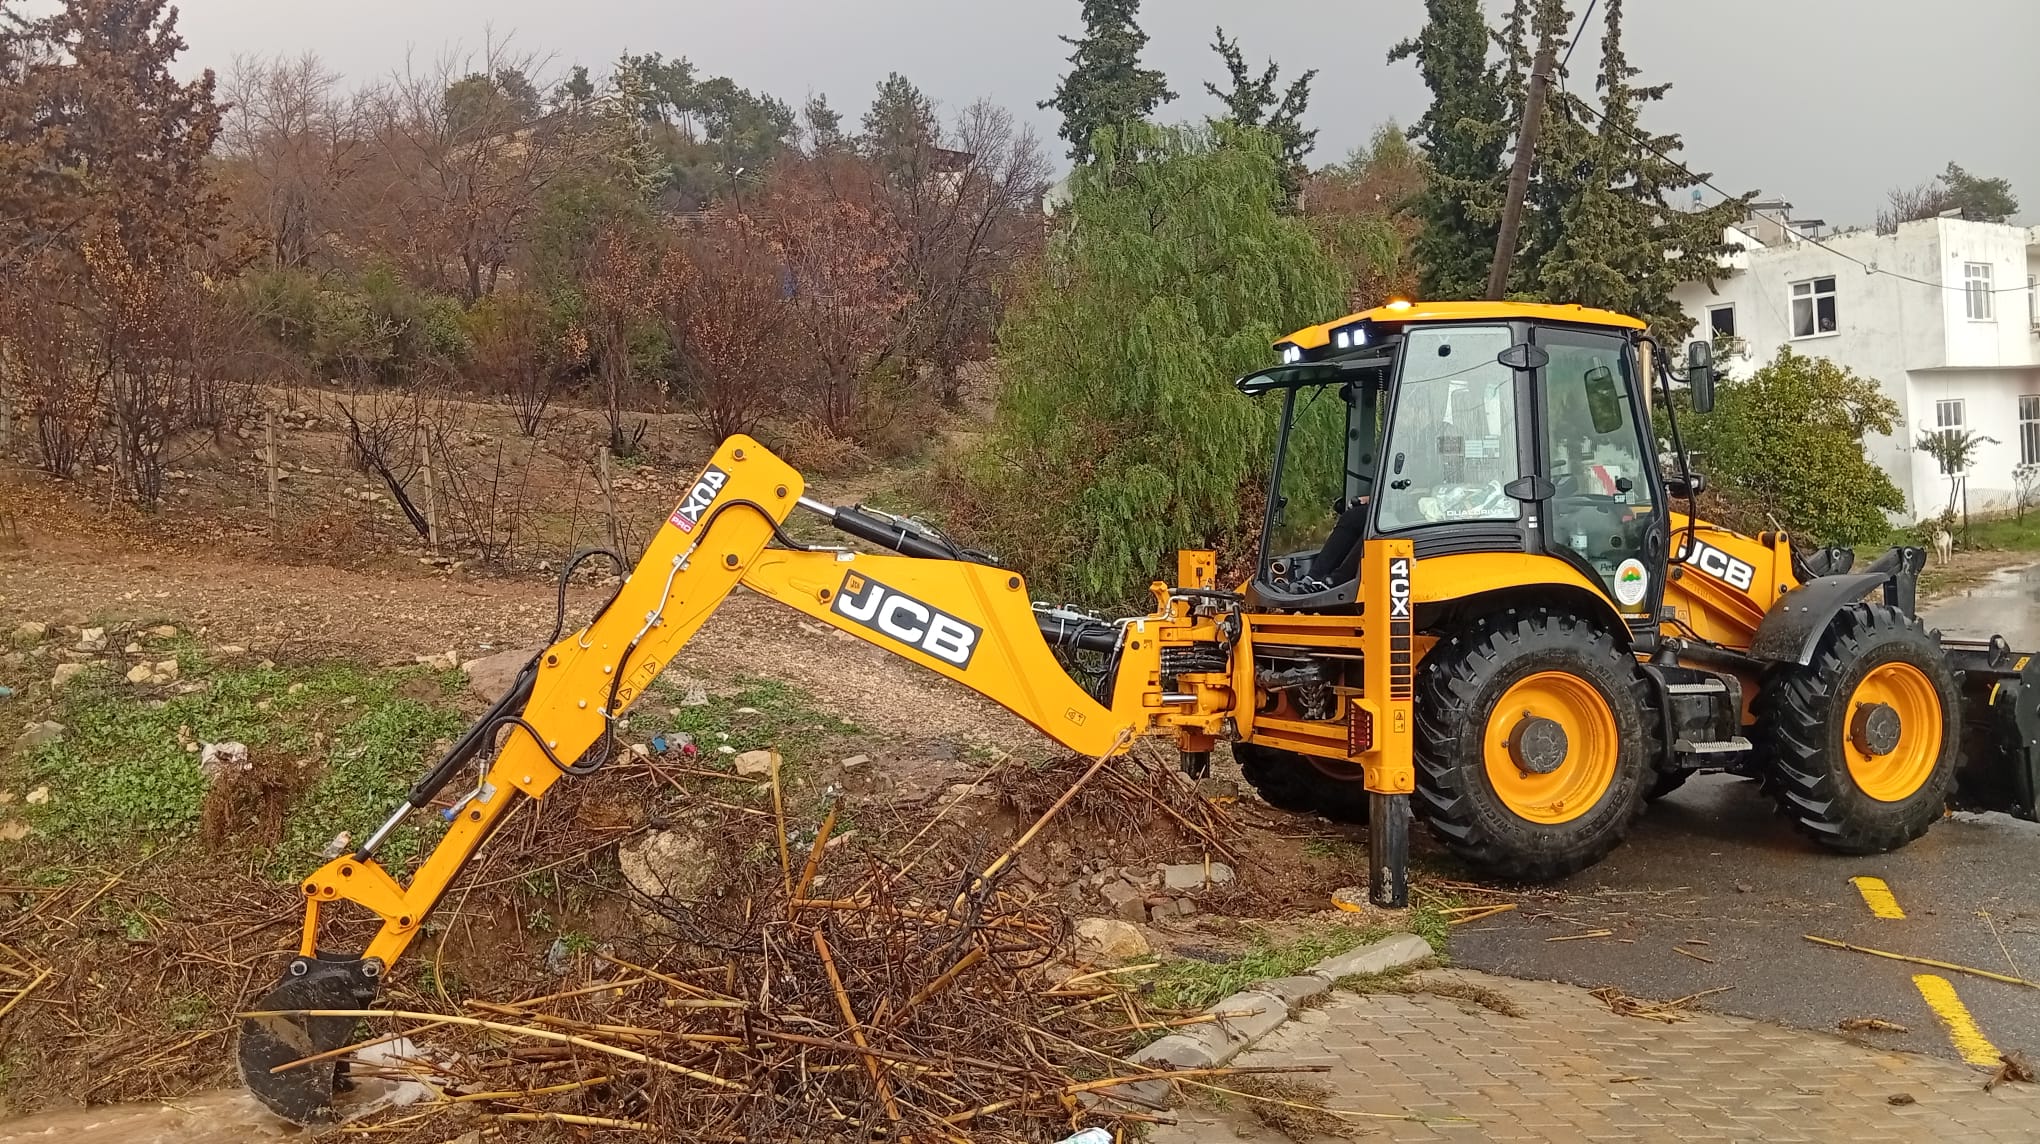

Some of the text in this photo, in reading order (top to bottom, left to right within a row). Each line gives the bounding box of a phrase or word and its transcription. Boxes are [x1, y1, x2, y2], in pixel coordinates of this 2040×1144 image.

[679, 471, 726, 522] 4CX
[671, 516, 692, 533] PRO
[1390, 559, 1410, 616] 4CX
[1678, 541, 1753, 590] JCB
[838, 585, 975, 664] JCB
